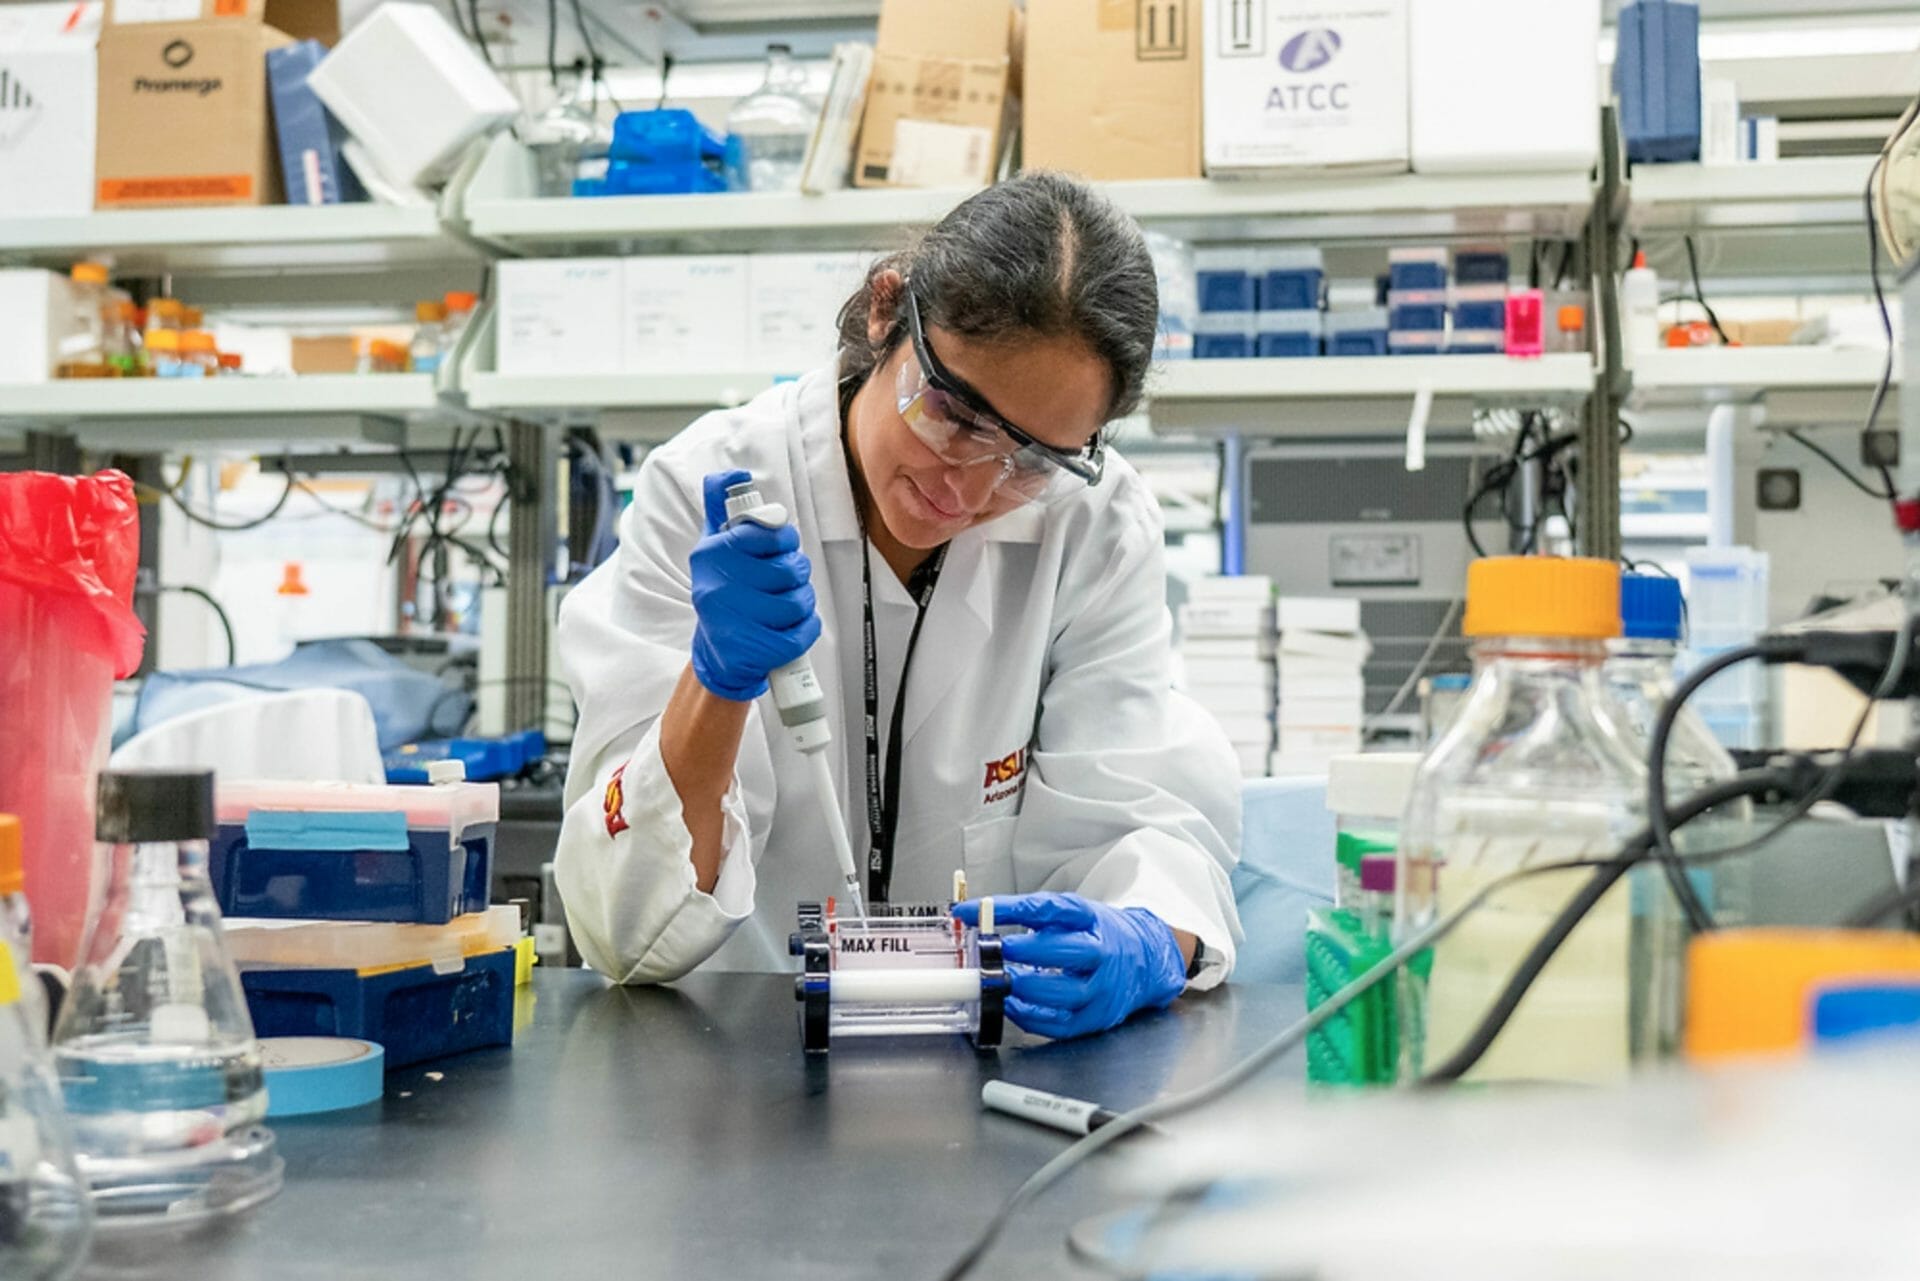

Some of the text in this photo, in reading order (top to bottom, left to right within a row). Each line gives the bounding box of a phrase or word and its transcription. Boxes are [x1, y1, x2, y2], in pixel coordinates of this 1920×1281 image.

[1265, 82, 1349, 111] ATCC
[841, 937, 911, 953] MAX FILL
